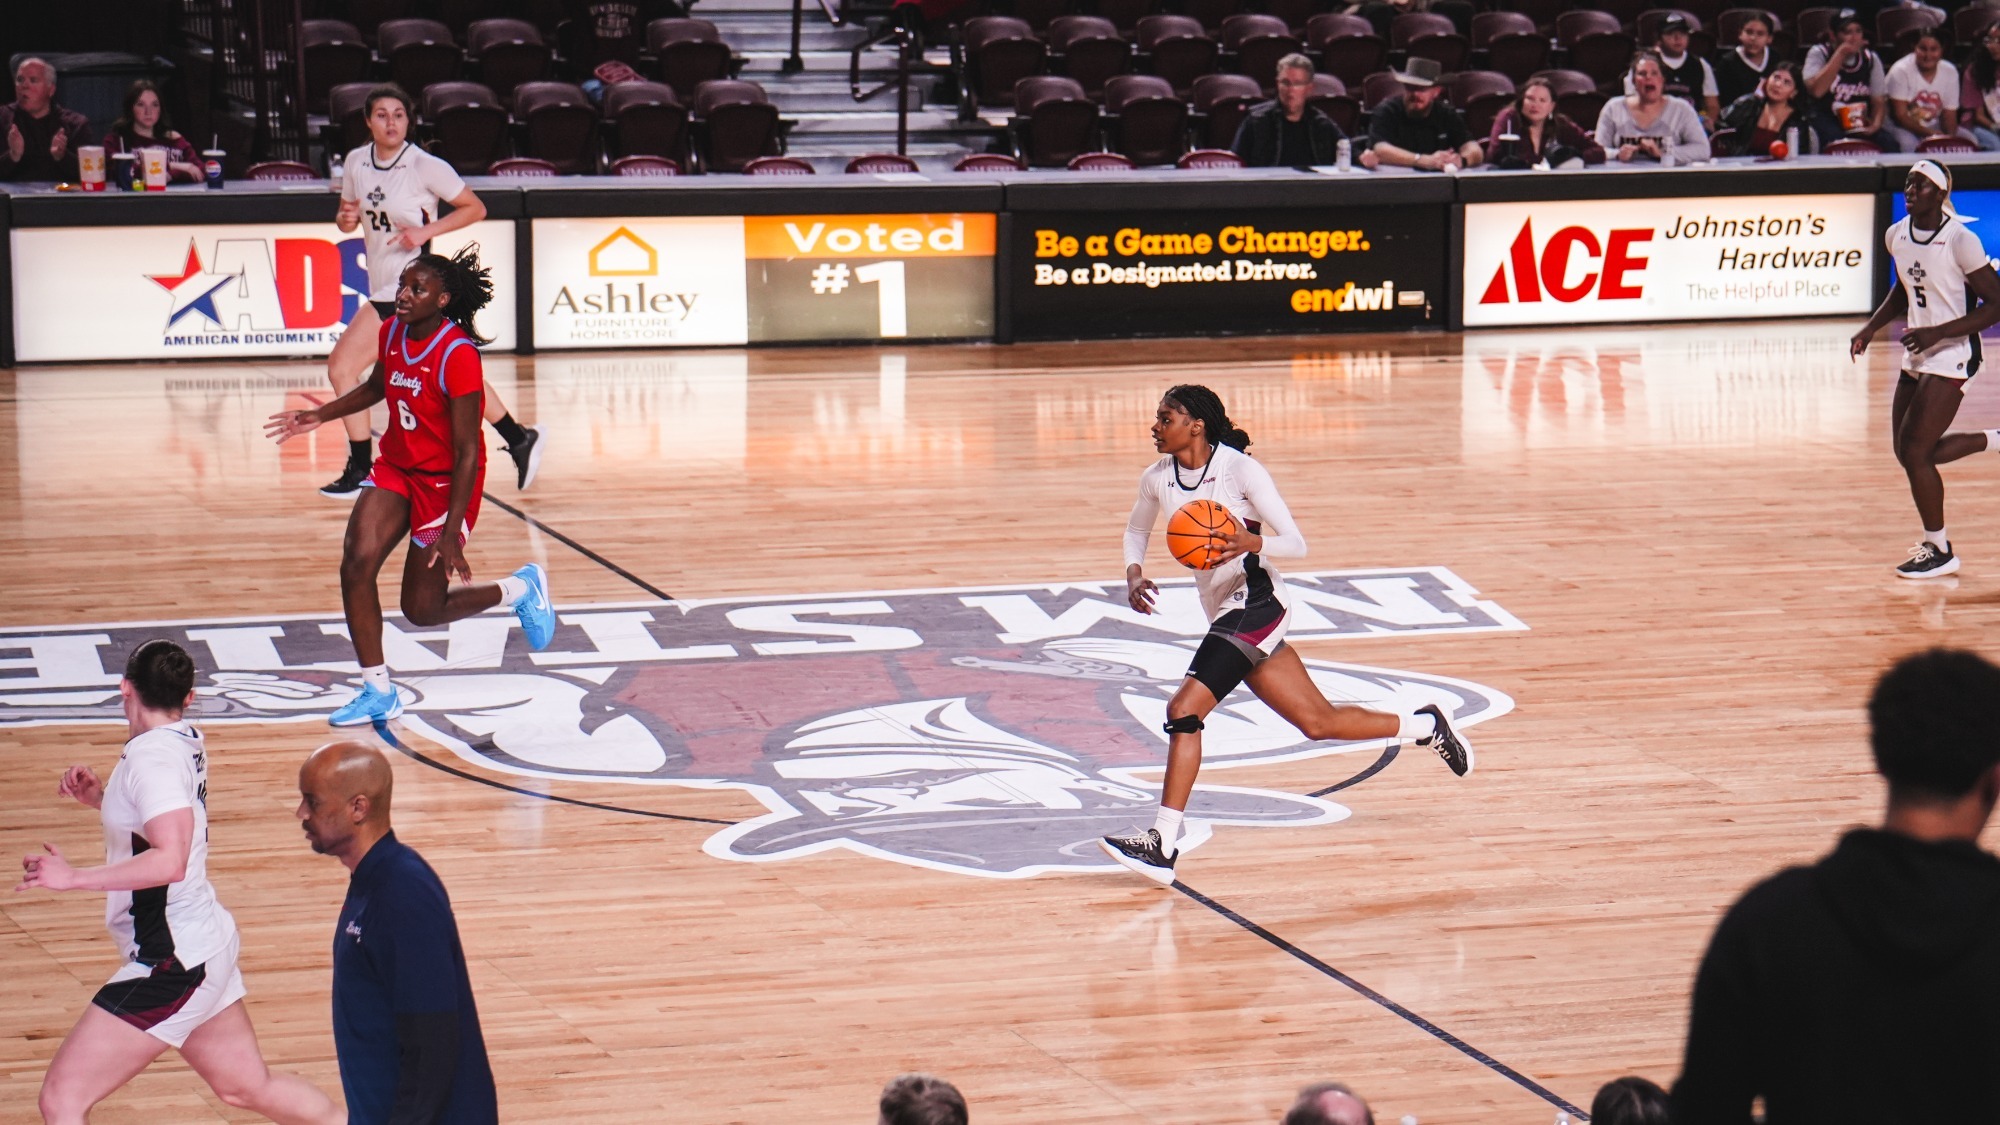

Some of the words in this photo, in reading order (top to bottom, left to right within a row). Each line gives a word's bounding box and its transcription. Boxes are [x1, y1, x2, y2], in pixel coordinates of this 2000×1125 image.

[366, 210, 392, 233] 24
[1665, 213, 1825, 239] Johnston's
[784, 222, 964, 252] Voted
[1034, 230, 1079, 257] Be
[1085, 235, 1108, 257] a
[1114, 229, 1213, 257] Game
[1218, 226, 1371, 258] Changer.
[1479, 215, 1655, 304] ACE
[1718, 246, 1862, 270] Hardware
[1034, 264, 1068, 286] Be
[1072, 267, 1089, 284] a
[1092, 261, 1232, 288] Designated
[1235, 259, 1317, 280] Driver.
[548, 283, 698, 321] Ashley
[811, 261, 907, 338] #1
[1291, 281, 1394, 312] endwi
[1686, 283, 1718, 301] The
[1725, 279, 1788, 304] Helpful
[1794, 280, 1841, 299] Place
[1913, 285, 1927, 308] 5
[569, 329, 677, 339] HOMESTORE
[574, 318, 672, 328] FURNITURE
[164, 334, 239, 346] AMERICAN
[245, 332, 324, 344] DOCUMENT
[389, 370, 422, 398] Liberty
[397, 399, 418, 431] 6
